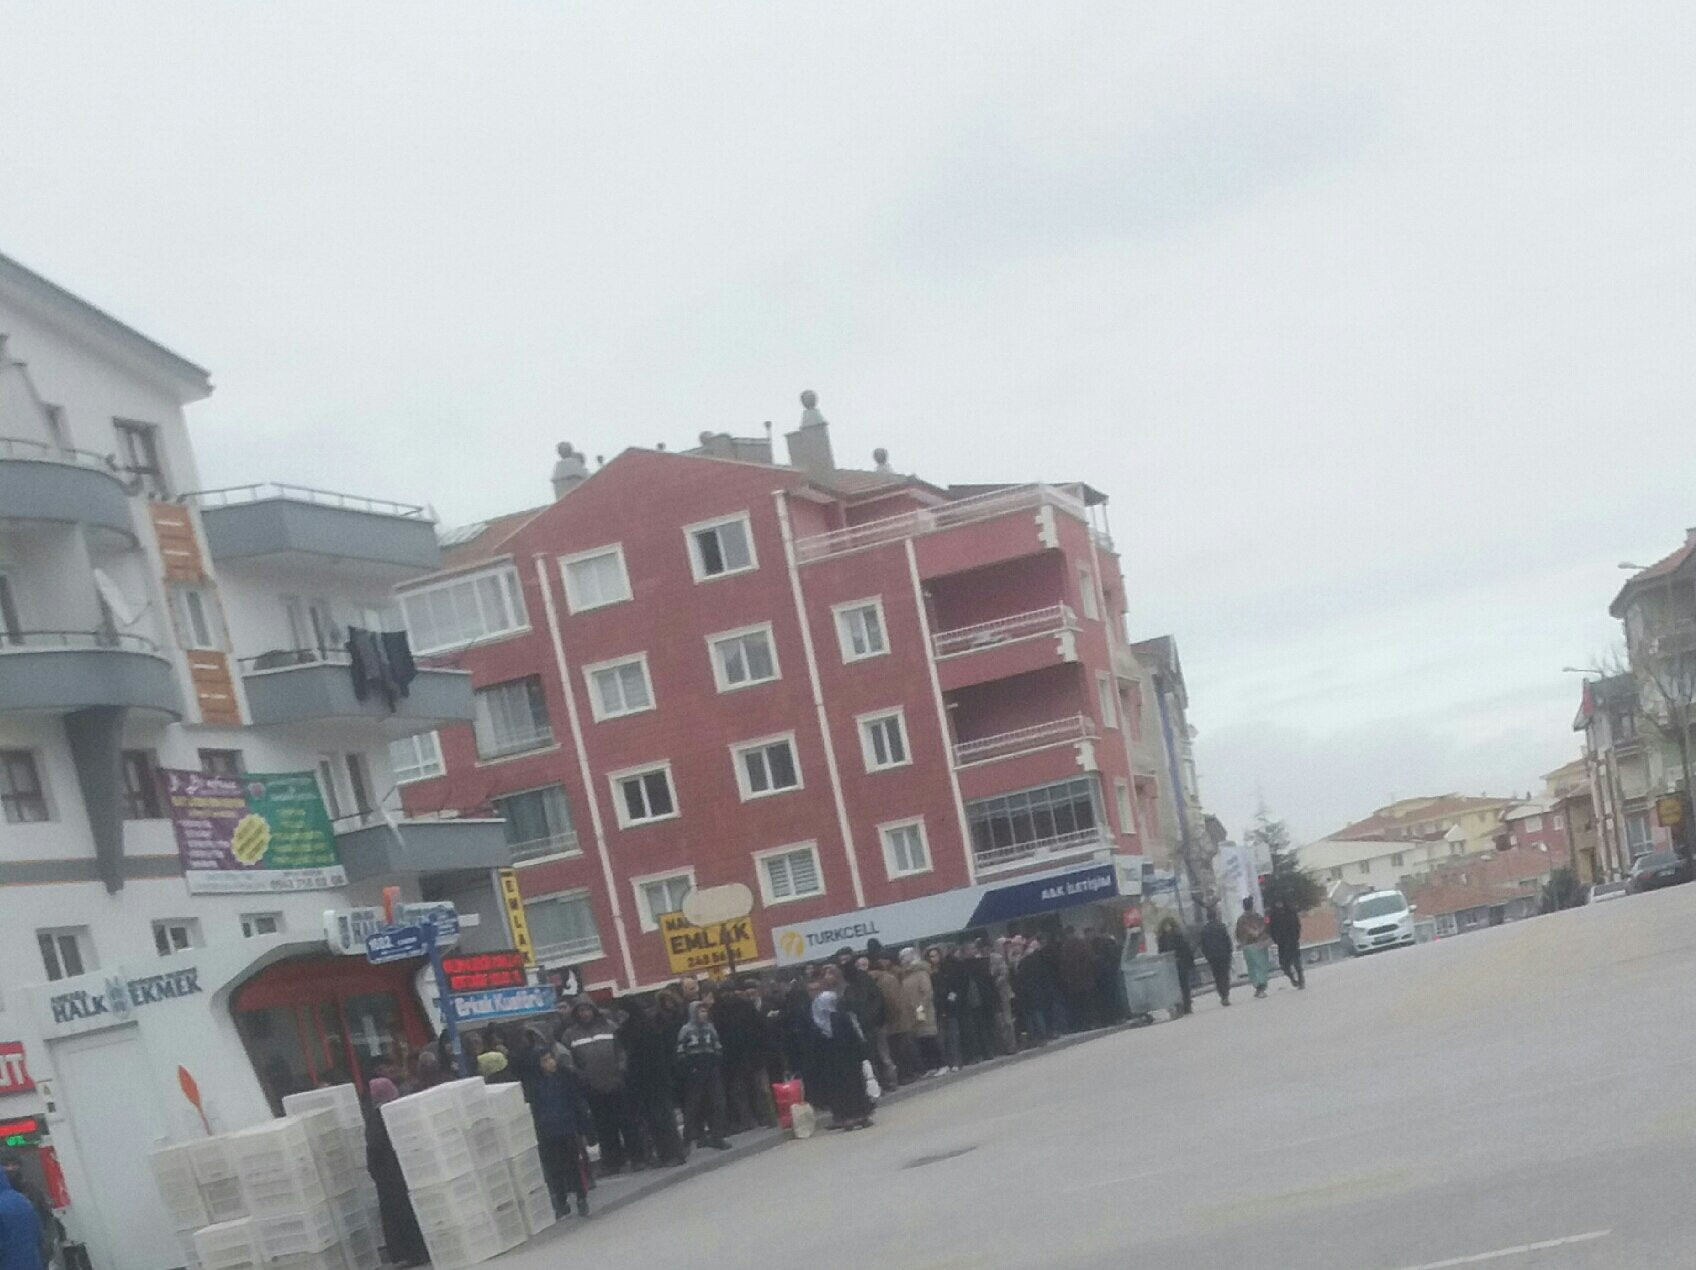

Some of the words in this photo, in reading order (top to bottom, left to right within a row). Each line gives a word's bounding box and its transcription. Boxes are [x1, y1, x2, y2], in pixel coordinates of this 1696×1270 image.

[805, 921, 879, 947] TURKCELL
[52, 994, 109, 1023] HALK
[129, 974, 202, 1006] EKMEK
